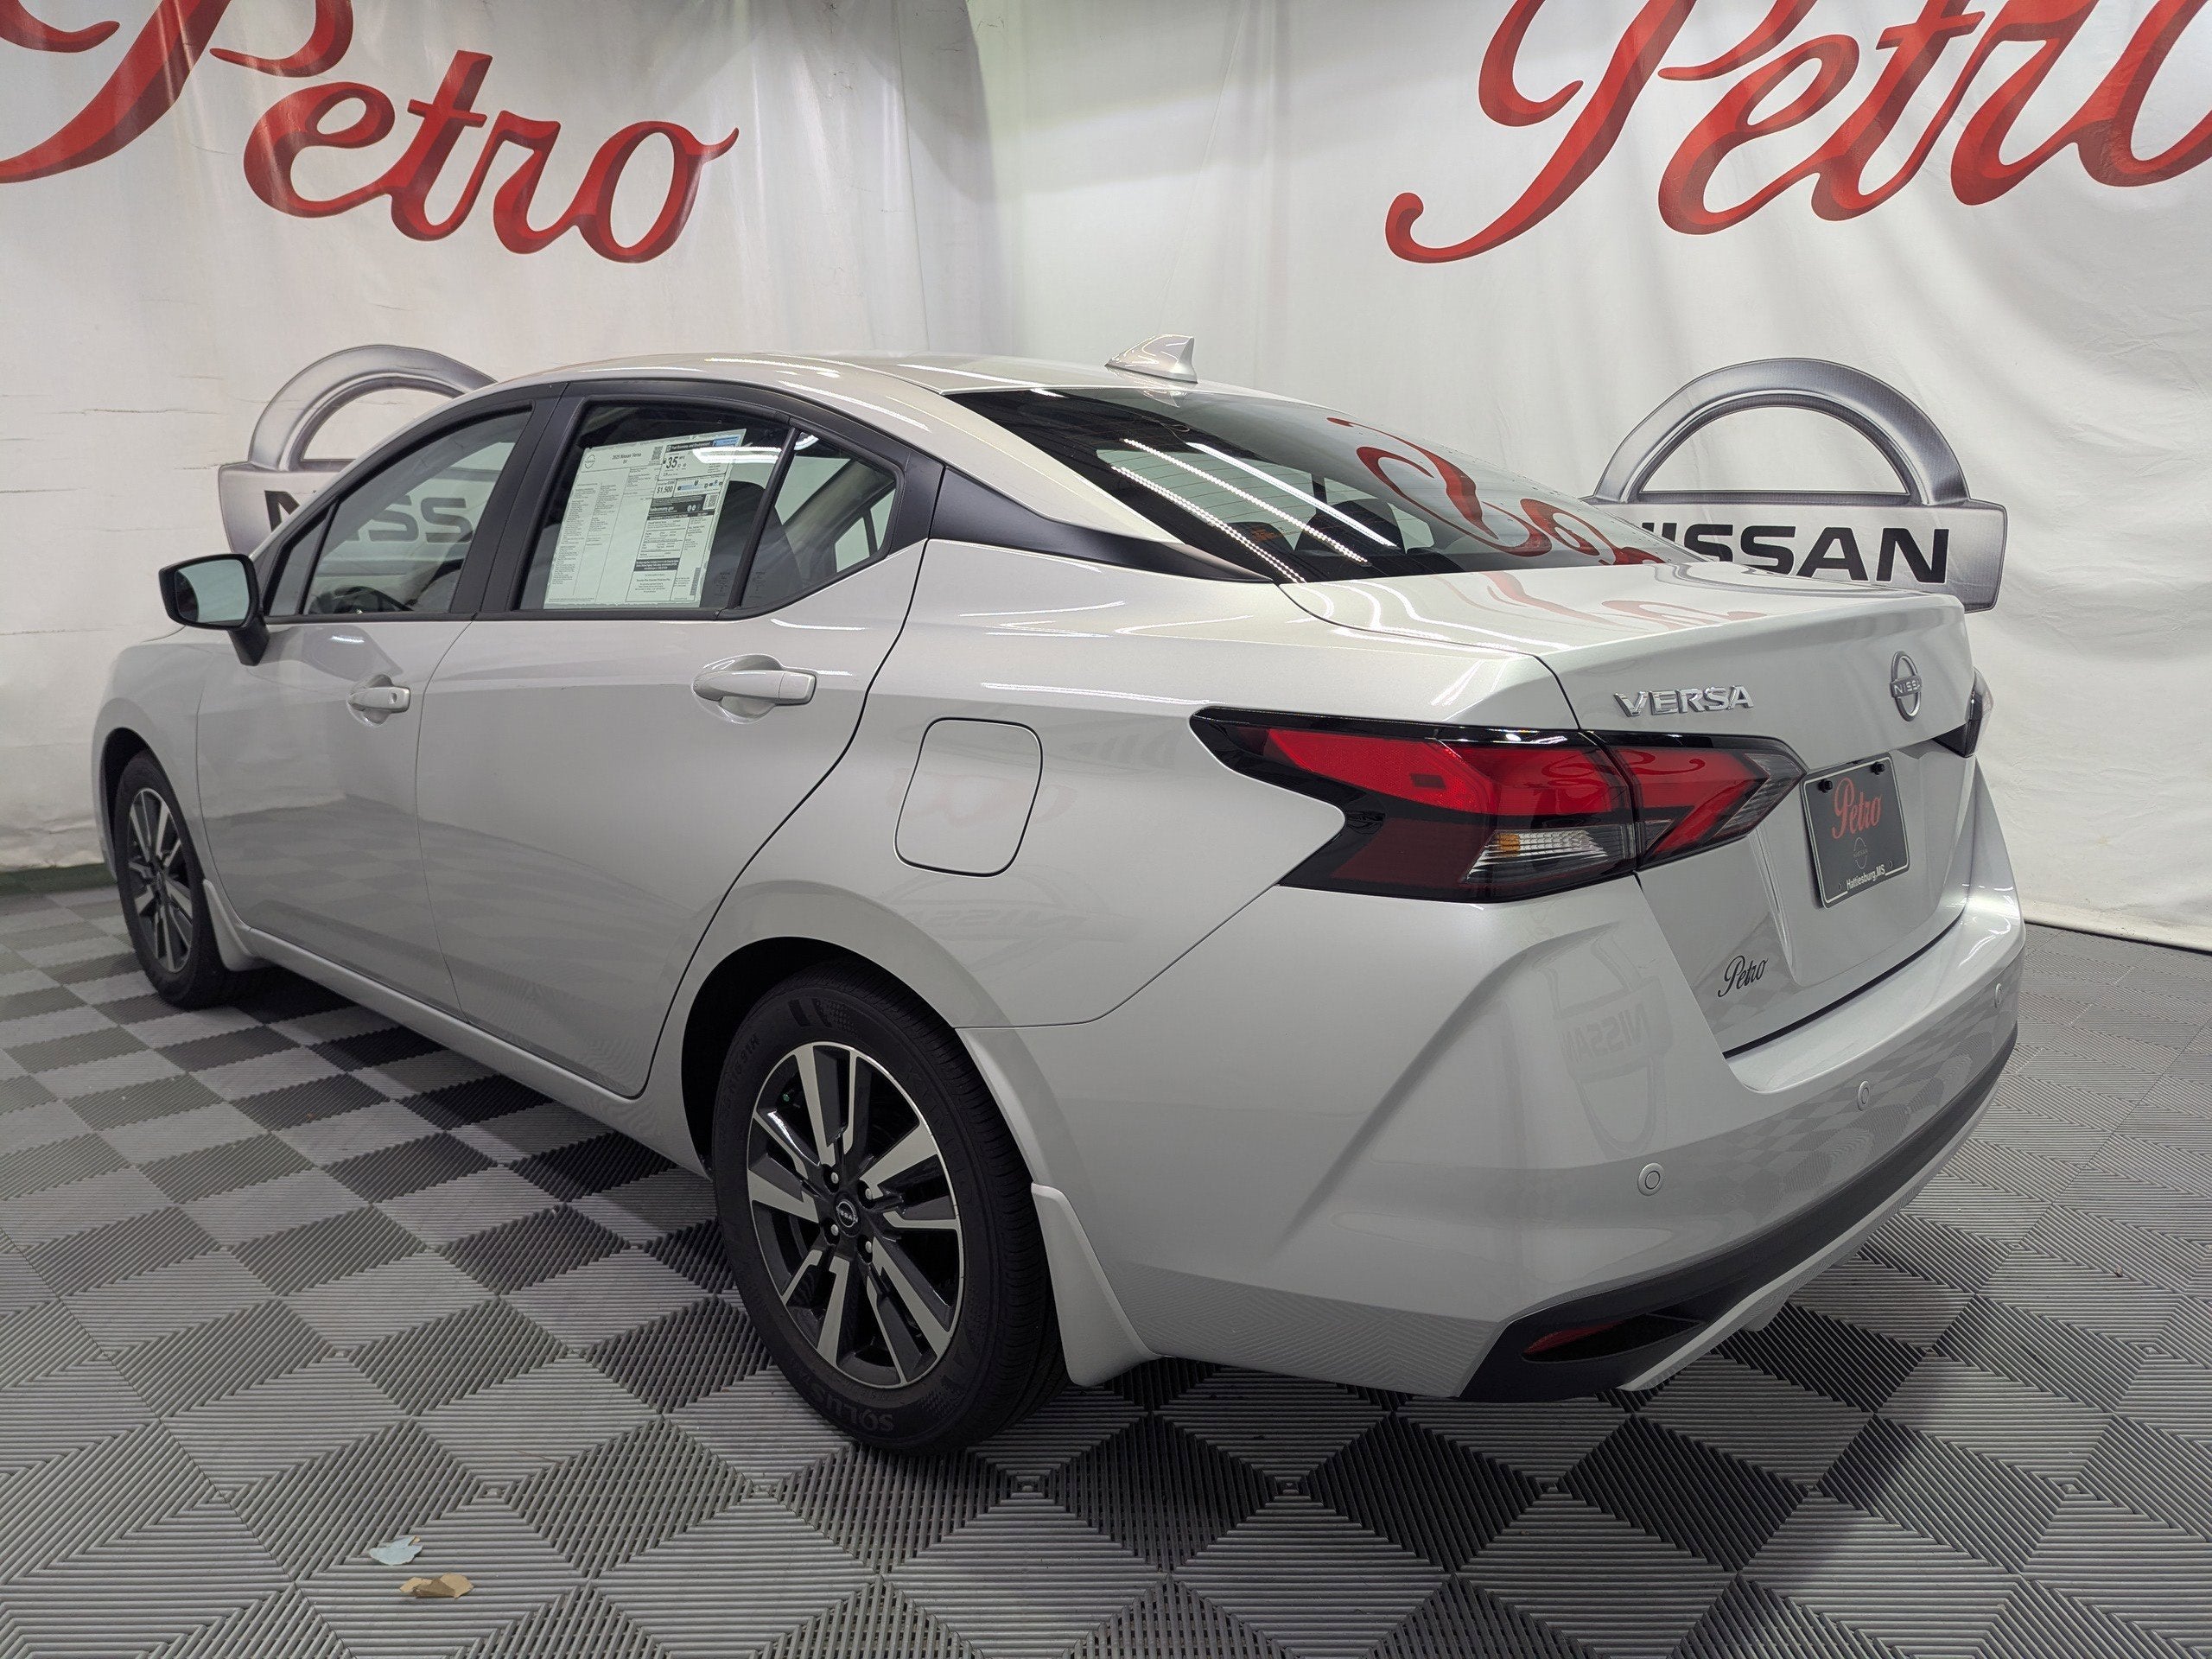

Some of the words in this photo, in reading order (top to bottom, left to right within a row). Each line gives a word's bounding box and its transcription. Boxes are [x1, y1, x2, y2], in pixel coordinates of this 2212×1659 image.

[666, 456, 678, 468] 35
[1642, 522, 1949, 584] SSAN
[1614, 685, 1754, 717] VERSA
[1831, 777, 1883, 839] Petro
[1717, 955, 1769, 997] Petro
